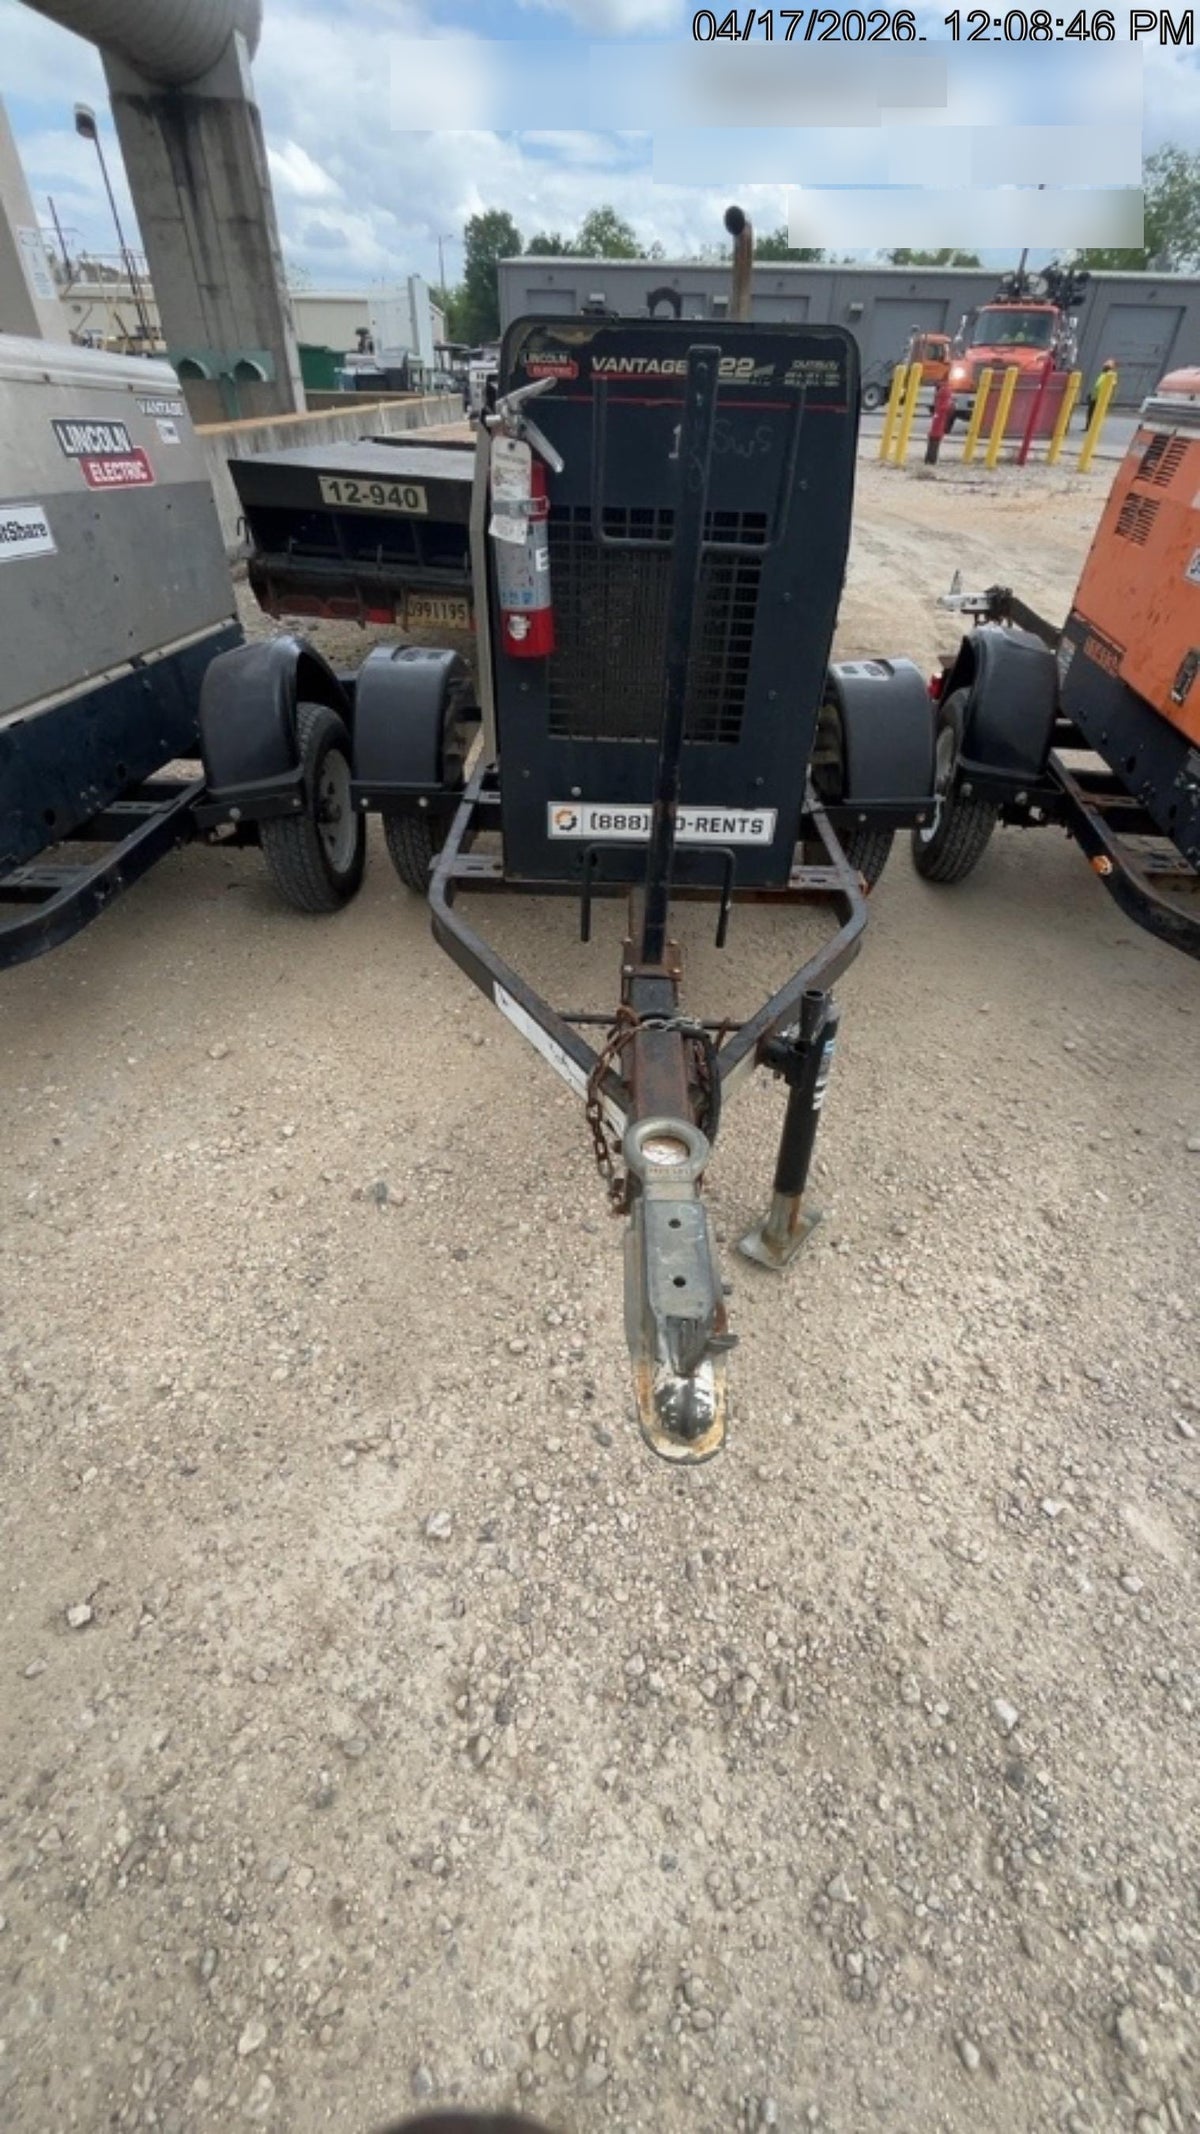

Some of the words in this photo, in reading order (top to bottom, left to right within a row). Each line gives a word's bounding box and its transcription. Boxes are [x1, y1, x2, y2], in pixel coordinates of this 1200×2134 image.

[591, 357, 688, 376] VANTAGE
[718, 357, 755, 378] 22
[56, 424, 132, 455] LINCOLN
[88, 461, 149, 482] ELECTRIC
[328, 480, 419, 509] 12-940
[590, 812, 648, 831] (888)
